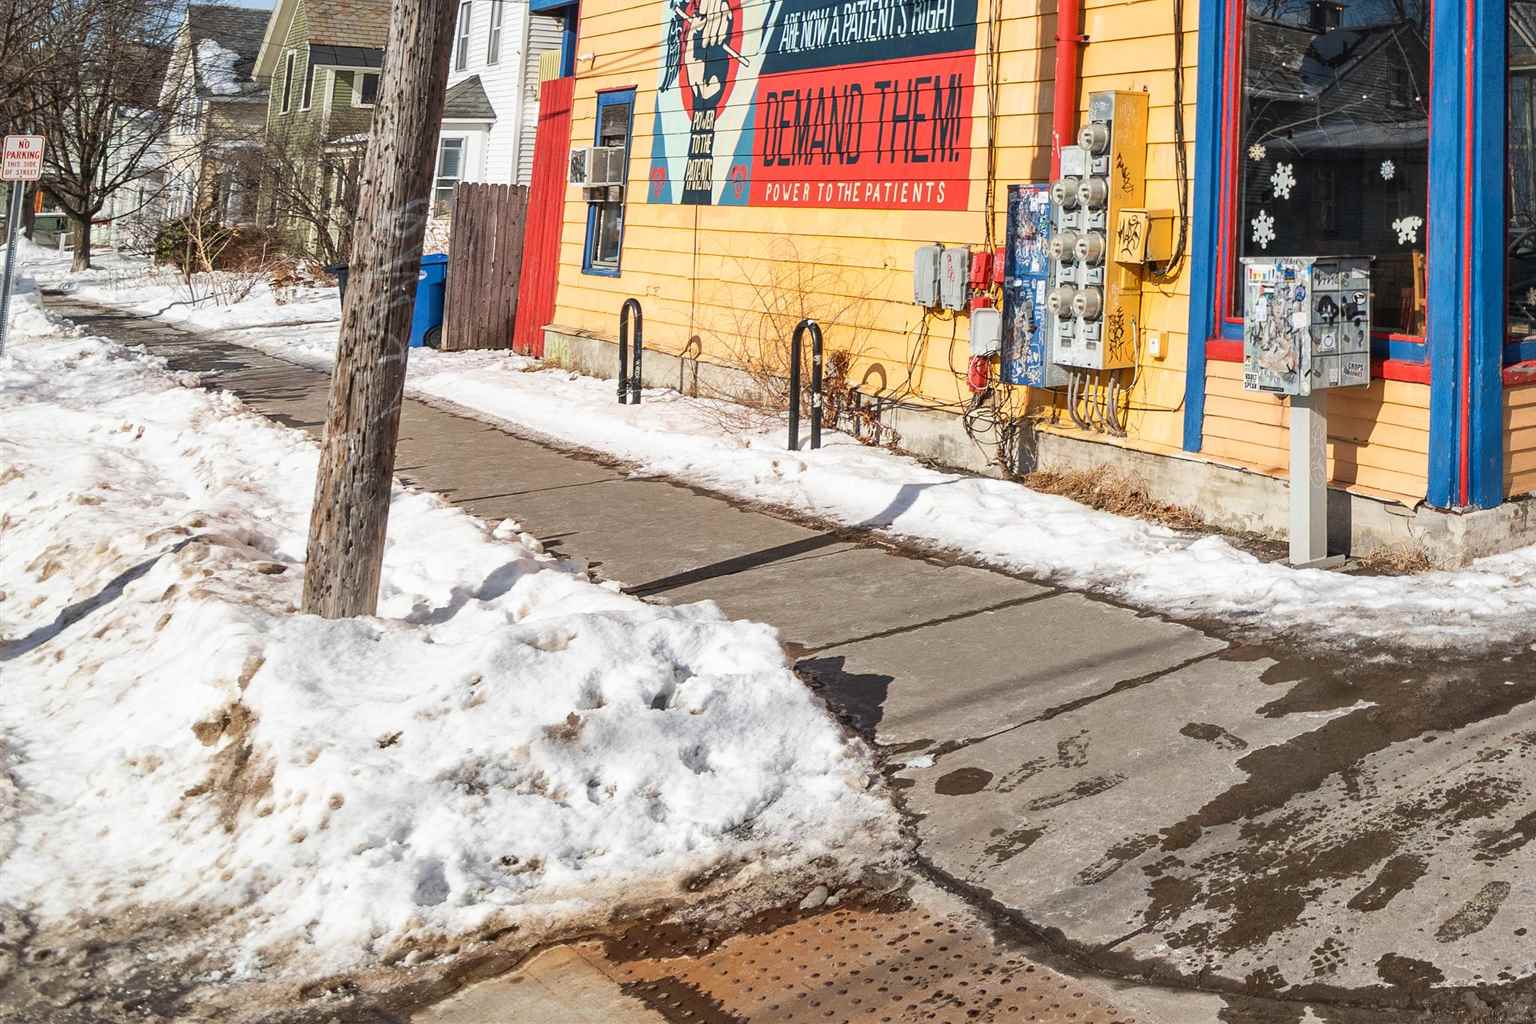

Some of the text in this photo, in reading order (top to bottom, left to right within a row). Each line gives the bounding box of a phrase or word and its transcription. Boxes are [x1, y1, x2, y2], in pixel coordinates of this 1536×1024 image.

[777, 13, 801, 54] ARE
[800, 7, 830, 51] NOW
[828, 6, 840, 47] A
[692, 110, 715, 130] POWER
[763, 73, 962, 167] DEMAND THEM!
[18, 140, 30, 149] NO
[692, 134, 712, 154] TO THE
[6, 151, 40, 160] PARKING
[765, 181, 945, 203] POWER TO THE PATIENTS
